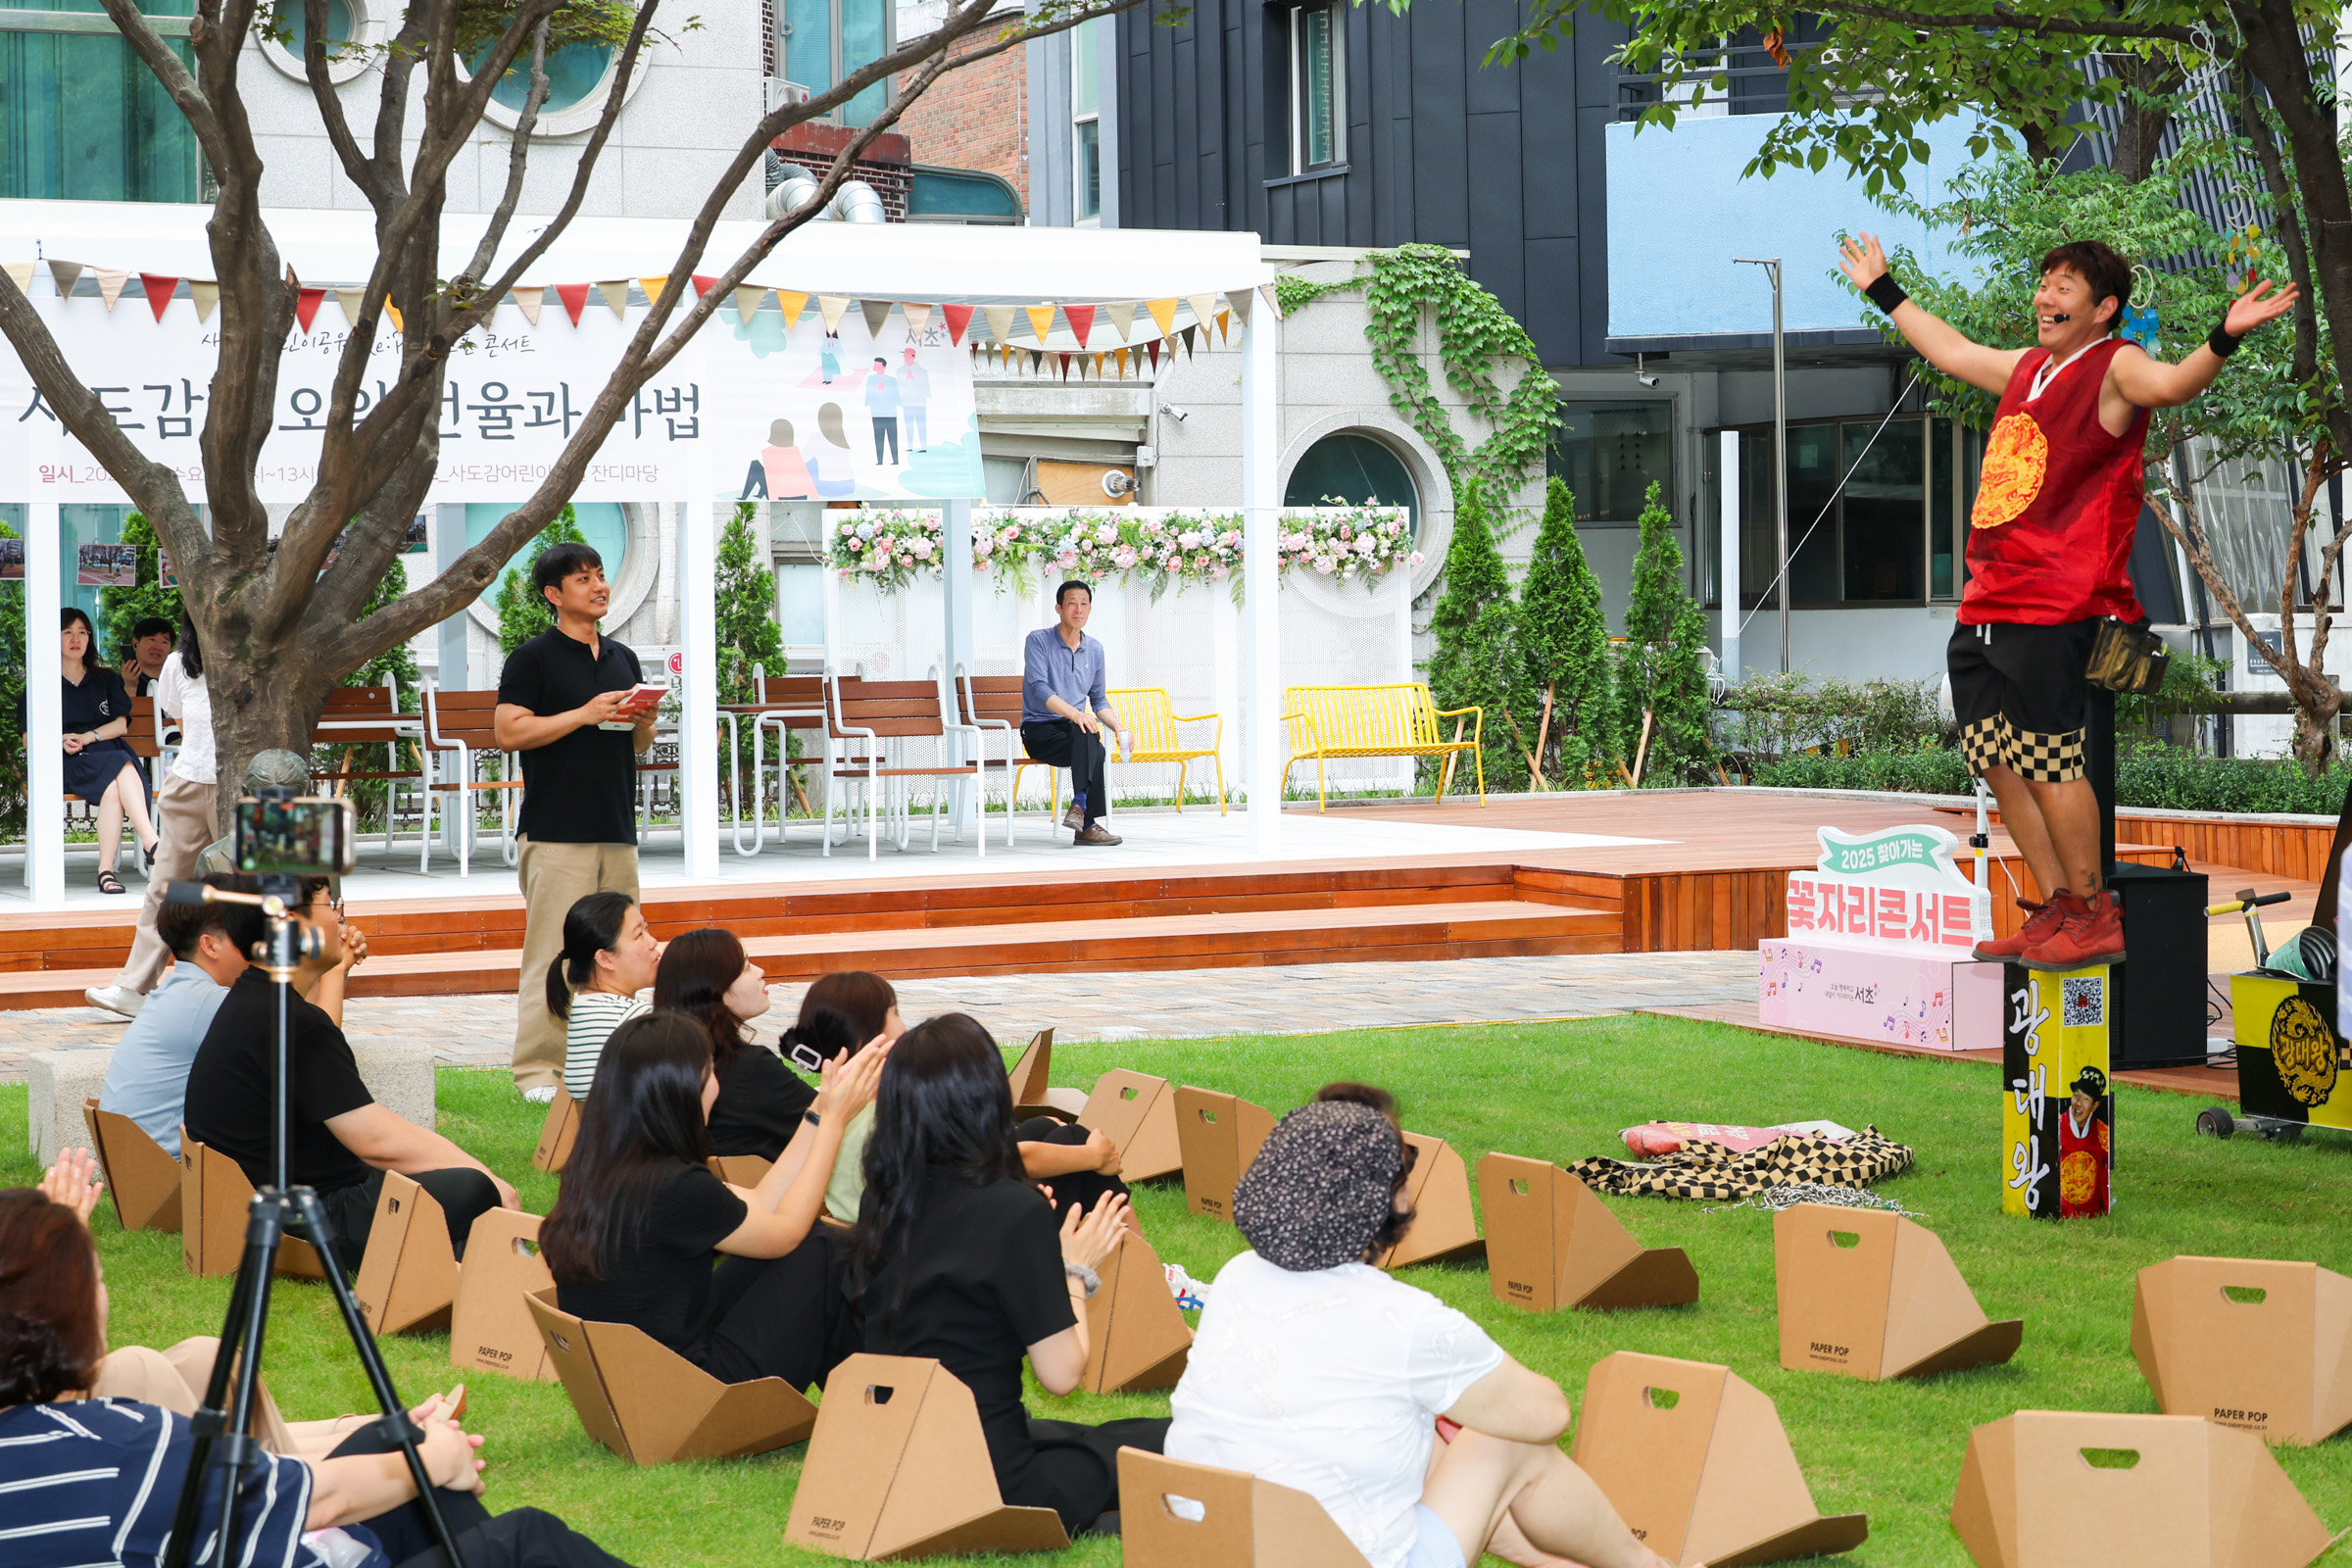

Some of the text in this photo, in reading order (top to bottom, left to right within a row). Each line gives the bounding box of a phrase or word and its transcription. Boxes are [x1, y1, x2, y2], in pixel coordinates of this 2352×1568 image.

[484, 333, 536, 358] 콘서트
[591, 464, 660, 483] 잔디마당
[1841, 838, 1924, 870] 2025 찾아가는
[1788, 879, 1974, 948] 꽃자리콘서트
[1854, 986, 1875, 1004] 서초
[2278, 1032, 2329, 1072] 광대왕
[2009, 978, 2051, 1211] 광대왕
[478, 1346, 513, 1362] PAPER POP
[1810, 1342, 1849, 1356] PAPER POP
[2214, 1407, 2268, 1422] PAPER POP
